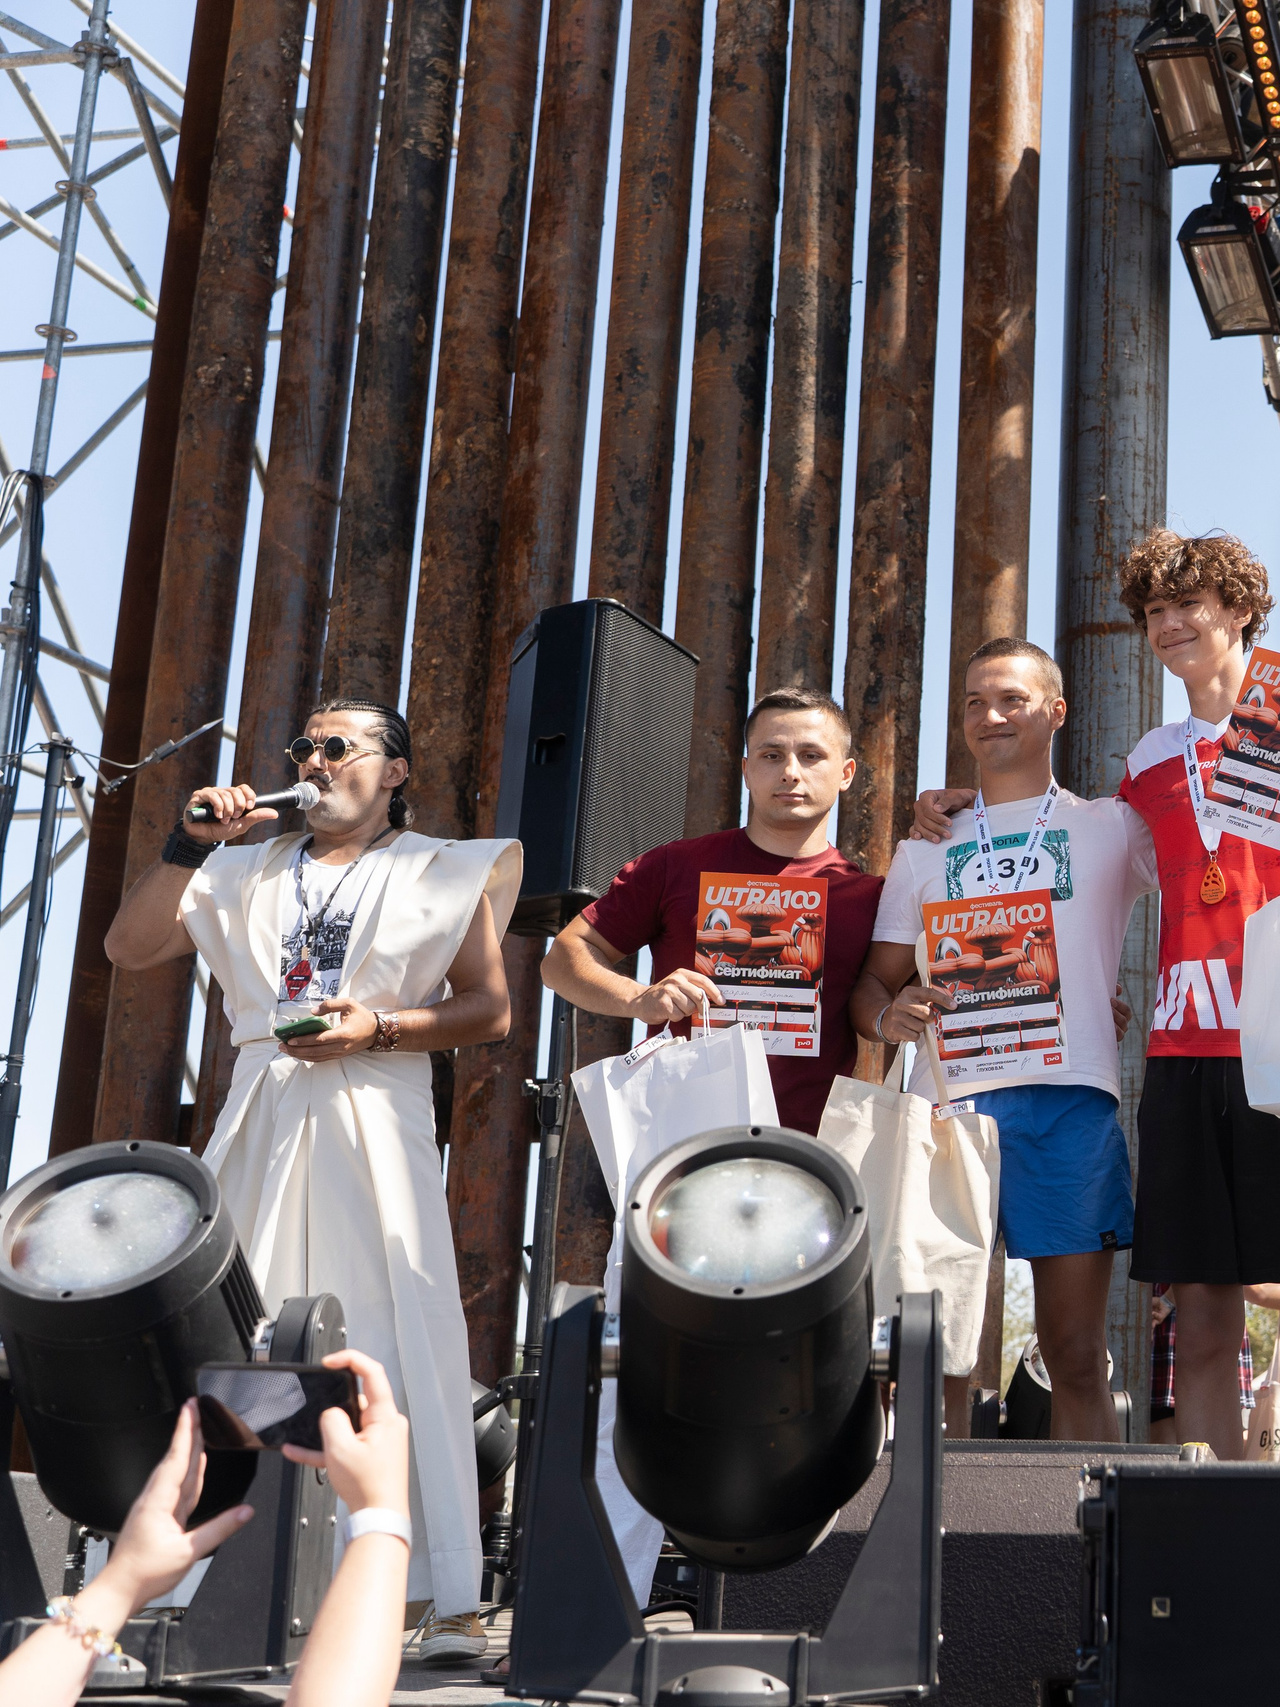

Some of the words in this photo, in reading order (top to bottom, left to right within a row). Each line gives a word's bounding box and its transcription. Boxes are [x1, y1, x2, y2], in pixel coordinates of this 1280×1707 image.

[704, 886, 821, 910] ULTRA100
[931, 903, 1046, 935] ULTRA100
[714, 966, 803, 980] сертификат
[954, 984, 1040, 1005] сертификат
[624, 1048, 640, 1065] БЕГ
